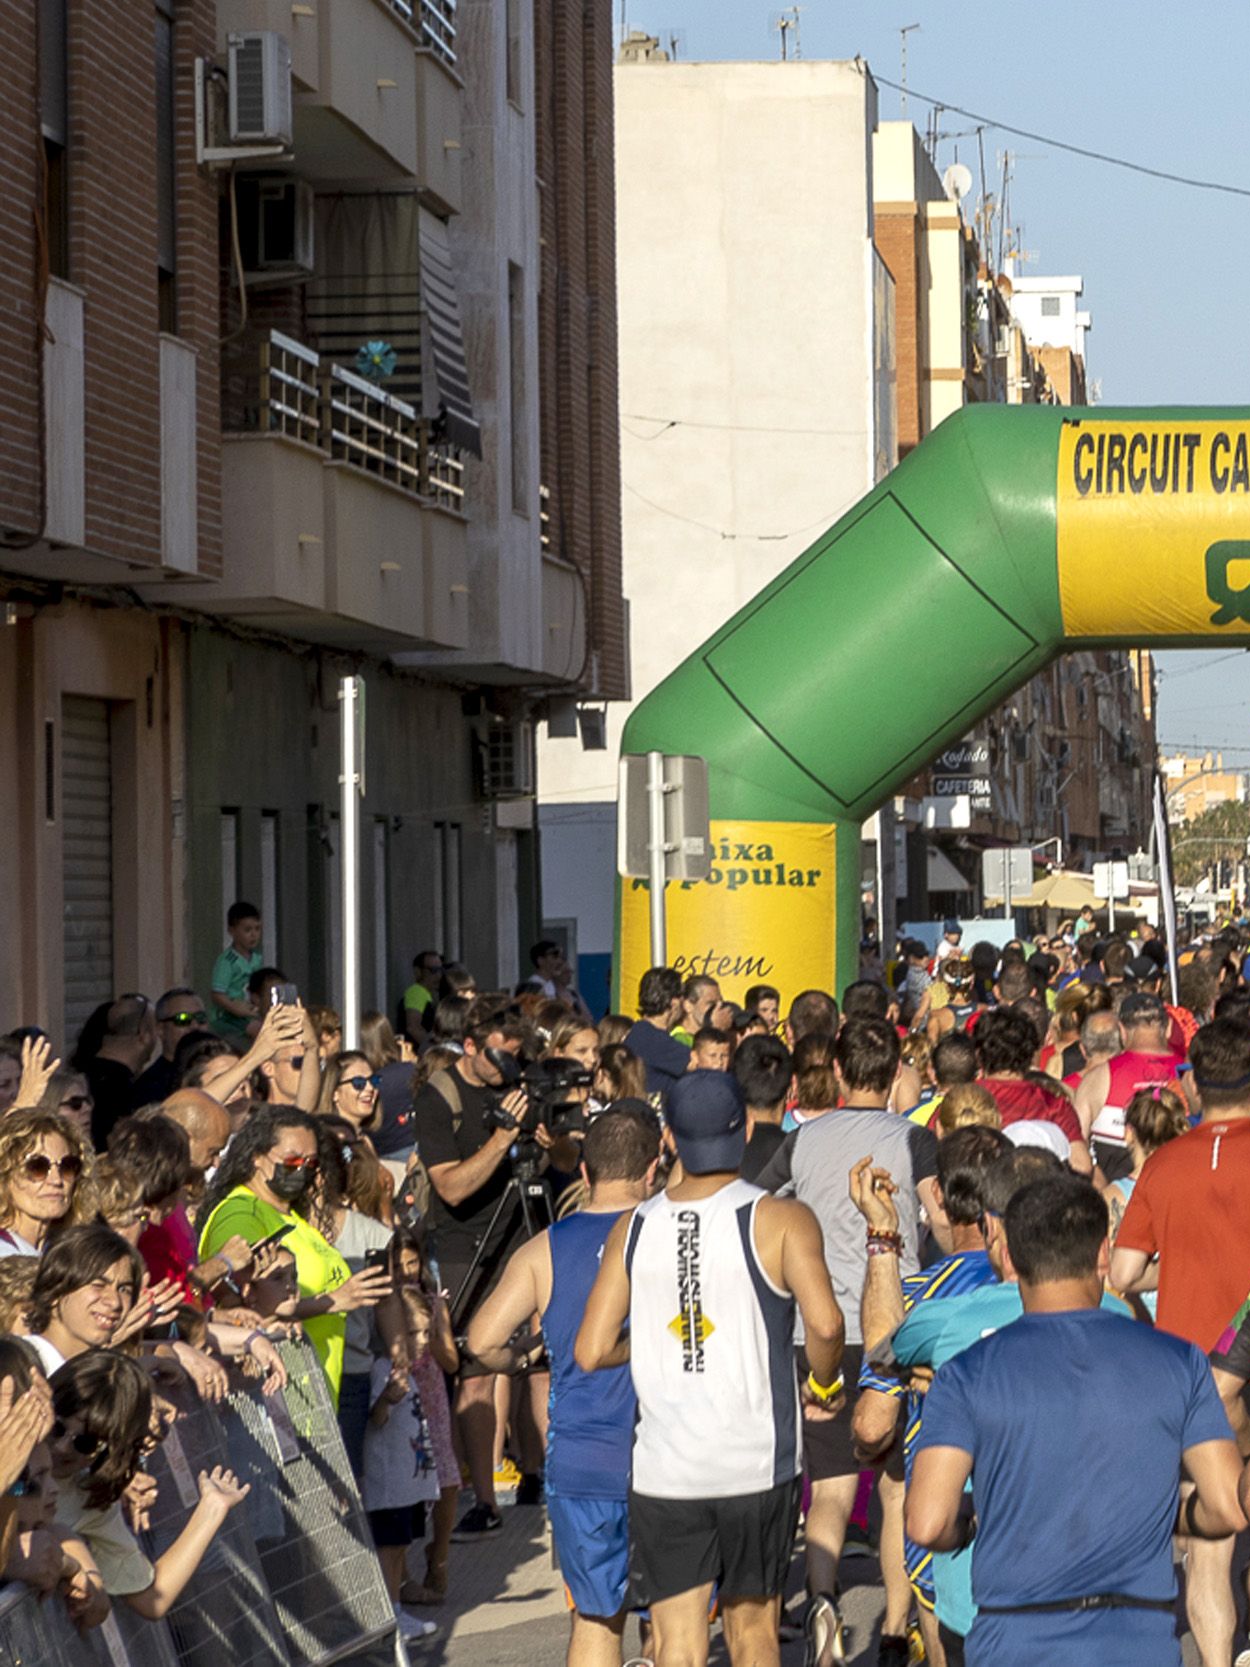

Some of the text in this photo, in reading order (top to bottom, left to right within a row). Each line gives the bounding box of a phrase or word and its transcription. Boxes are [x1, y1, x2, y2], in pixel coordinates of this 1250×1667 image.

[1074, 432, 1201, 495] CIRCUIT
[936, 779, 991, 796] CAFETERIA
[709, 838, 774, 861] ixa
[672, 949, 774, 978] estem
